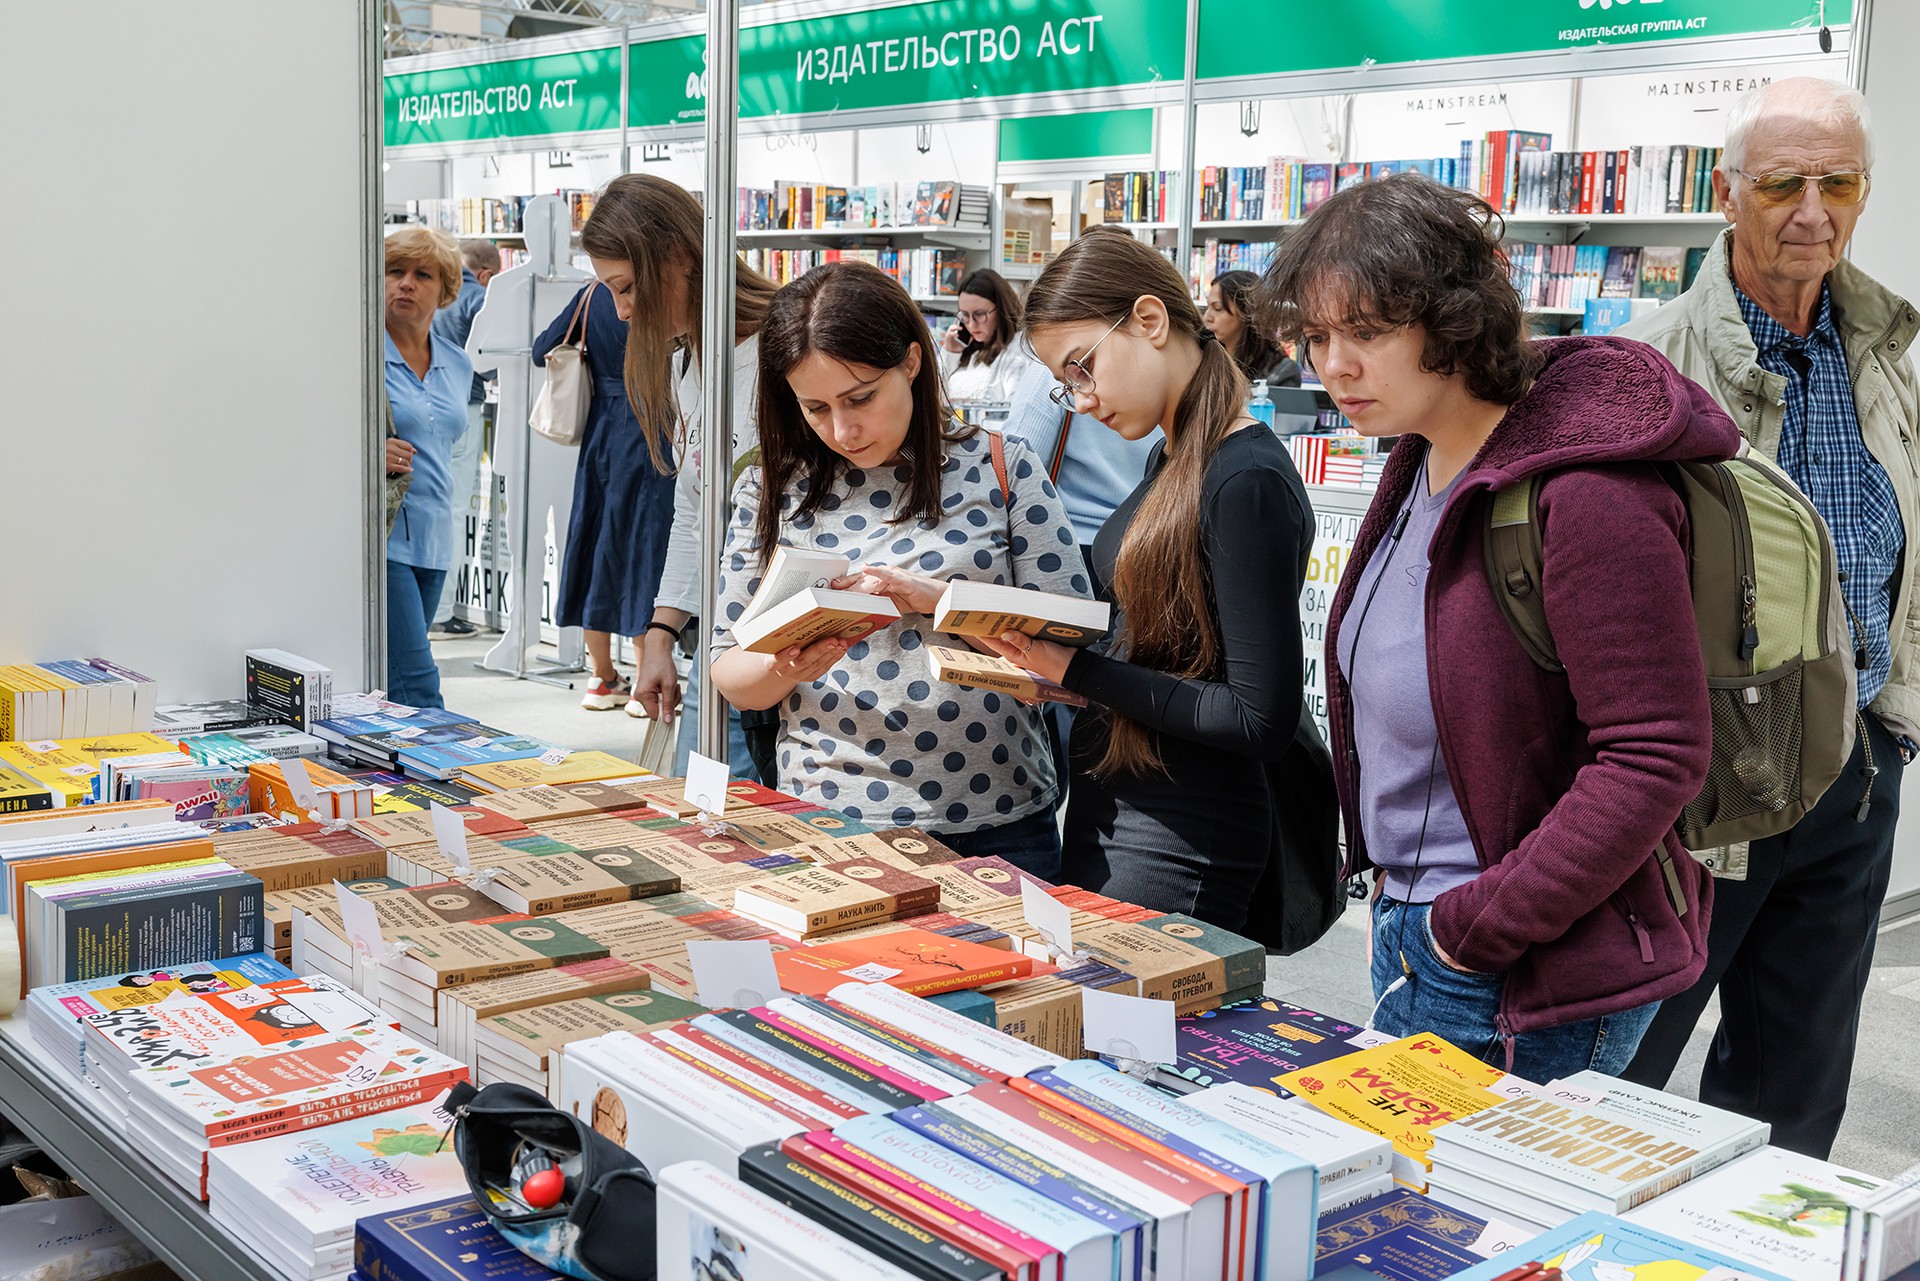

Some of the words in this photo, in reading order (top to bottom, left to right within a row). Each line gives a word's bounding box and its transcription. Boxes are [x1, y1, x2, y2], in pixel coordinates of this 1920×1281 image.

[1558, 23, 1639, 41] ИЗДАТЕЛЬСКАЯ
[1641, 20, 1684, 34] ГРУППА
[1685, 17, 1708, 29] АСТ
[796, 24, 1021, 85] ИЗДАТЕЛЬСТВО
[1036, 14, 1103, 58] АСТ
[1648, 77, 1772, 97] MAINSTREAM
[398, 83, 532, 124] ИЗДАТЕЛЬСТВО
[539, 79, 577, 109] АСТ
[1406, 93, 1507, 112] MAINSTREAM
[967, 675, 988, 685] ГЕНИЙ
[989, 678, 1021, 690] ОБЩЕНИЯ
[787, 876, 835, 894] НАУКА
[808, 871, 849, 888] ЖИТЬ
[563, 892, 597, 902] МОРФОЛОГИЯ
[563, 899, 593, 909] ВОЛШЕБНОЙ
[594, 897, 613, 906] СКАЗКИ
[838, 907, 862, 921] НАУКА
[864, 902, 885, 914] ЖИТЬ
[914, 974, 977, 993] ЭКЗИСТЕНЦИАЛЬНОГО
[978, 969, 1004, 980] АНАЛИЗА
[1171, 988, 1181, 1001] ОТ
[1182, 981, 1213, 998] ТРЕВОГИ
[1172, 971, 1206, 990] СВОБОДА
[751, 1021, 828, 1058] БЕССОЗНАТЕЛЬНОГО
[1181, 1026, 1300, 1071] ОВЕРШЕНСТВО
[1200, 1044, 1250, 1066] ТЫ
[820, 1055, 875, 1082] ПСИХОЛОГИЯ
[299, 1100, 329, 1113] ЖИТЬ,
[330, 1098, 337, 1106] А
[338, 1093, 352, 1104] НЕ
[353, 1079, 420, 1101] ТРЕВОЖИТЬСЯ
[302, 1112, 331, 1126] ЖИТЬ,
[332, 1110, 340, 1119] А
[341, 1106, 354, 1117] НЕ
[356, 1091, 422, 1113] ТРЕВОЖИТЬСЯ
[1098, 1077, 1202, 1127] ПСИХОЛОГИЯ
[1367, 1095, 1407, 1116] НЕ
[1493, 1096, 1700, 1166] ПРИВЫЧКИ
[1452, 1110, 1666, 1183] АТОМНЫЕ
[296, 1140, 397, 1199] СЕКСУАЛЬНОЙ
[879, 1134, 993, 1191] ПСИХОЛОГИЯ
[285, 1154, 370, 1205] ИСЦЕЛЕНИЕ
[361, 1158, 425, 1194] ТРАВМЫ
[786, 1161, 872, 1211] БЕССОЗНАТЕЛЬНОГО
[1319, 1170, 1346, 1186] ПРАВИЛ
[1348, 1192, 1373, 1208] ЖИЗНИ
[870, 1208, 935, 1244] ПСИХОЛОГИЯ
